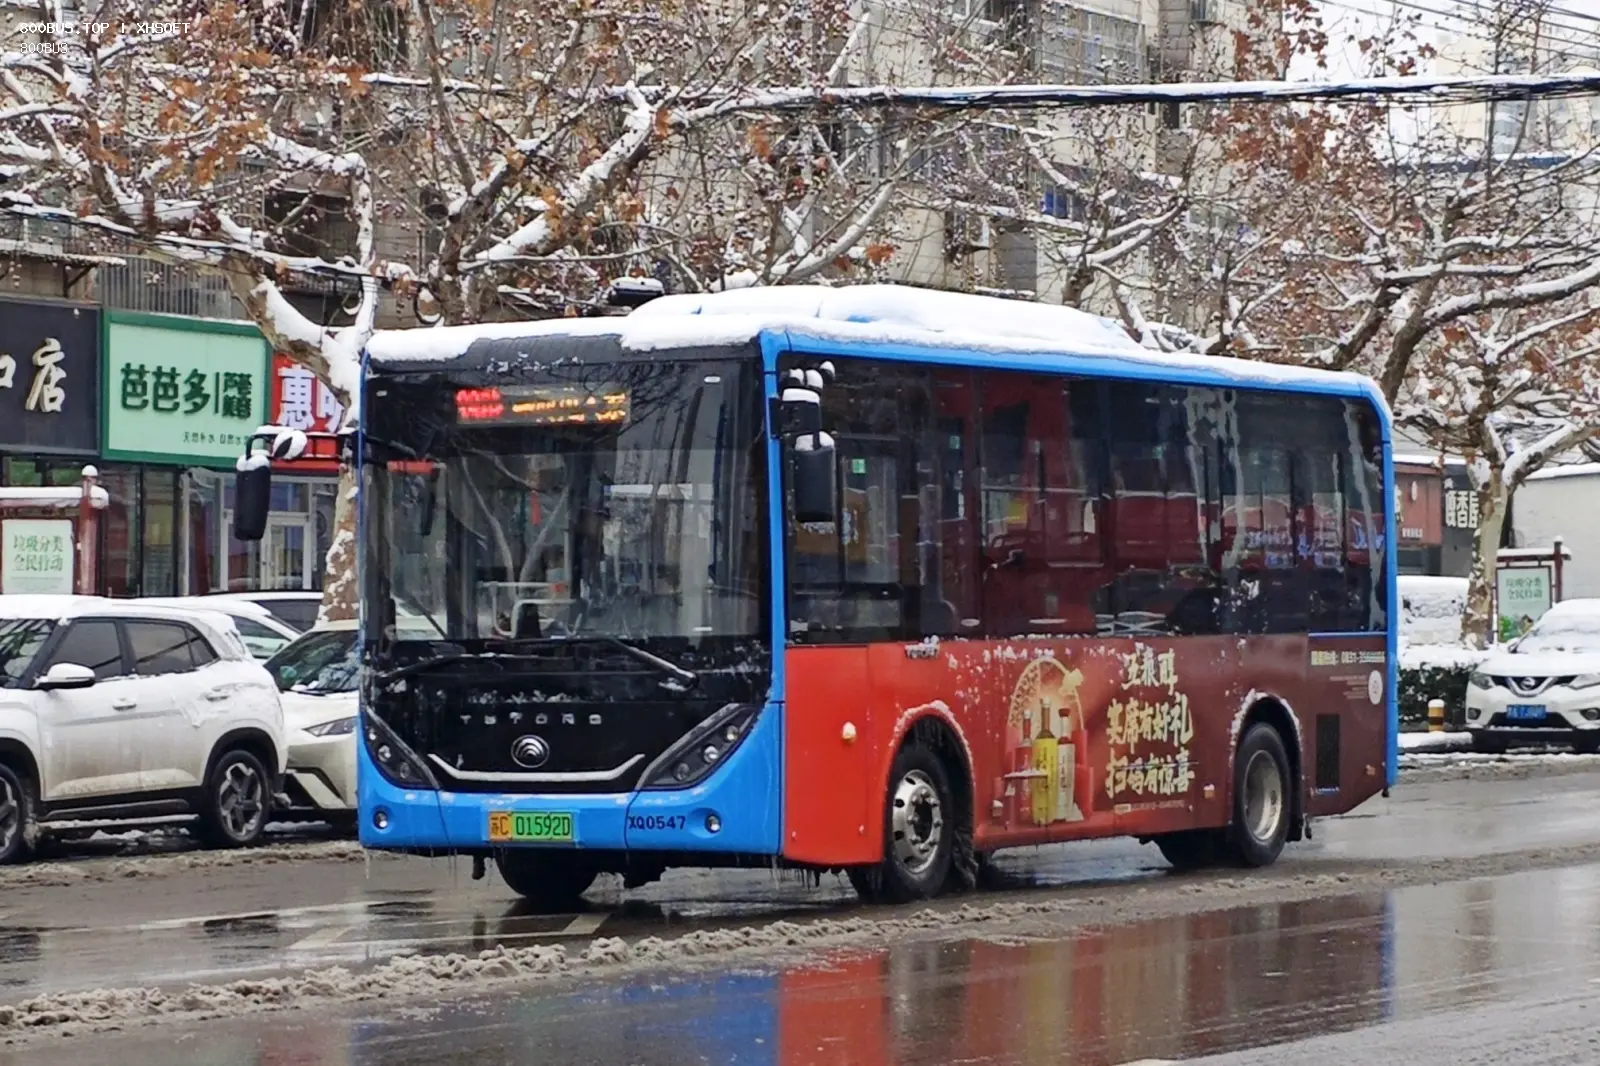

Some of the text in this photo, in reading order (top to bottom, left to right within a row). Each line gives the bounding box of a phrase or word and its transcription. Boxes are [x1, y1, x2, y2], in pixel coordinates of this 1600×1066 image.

[120, 362, 211, 415] 芭芭多
[12, 534, 64, 552] 垃圾分类
[12, 553, 64, 571] 全民行动
[628, 815, 686, 831] XQ0547
